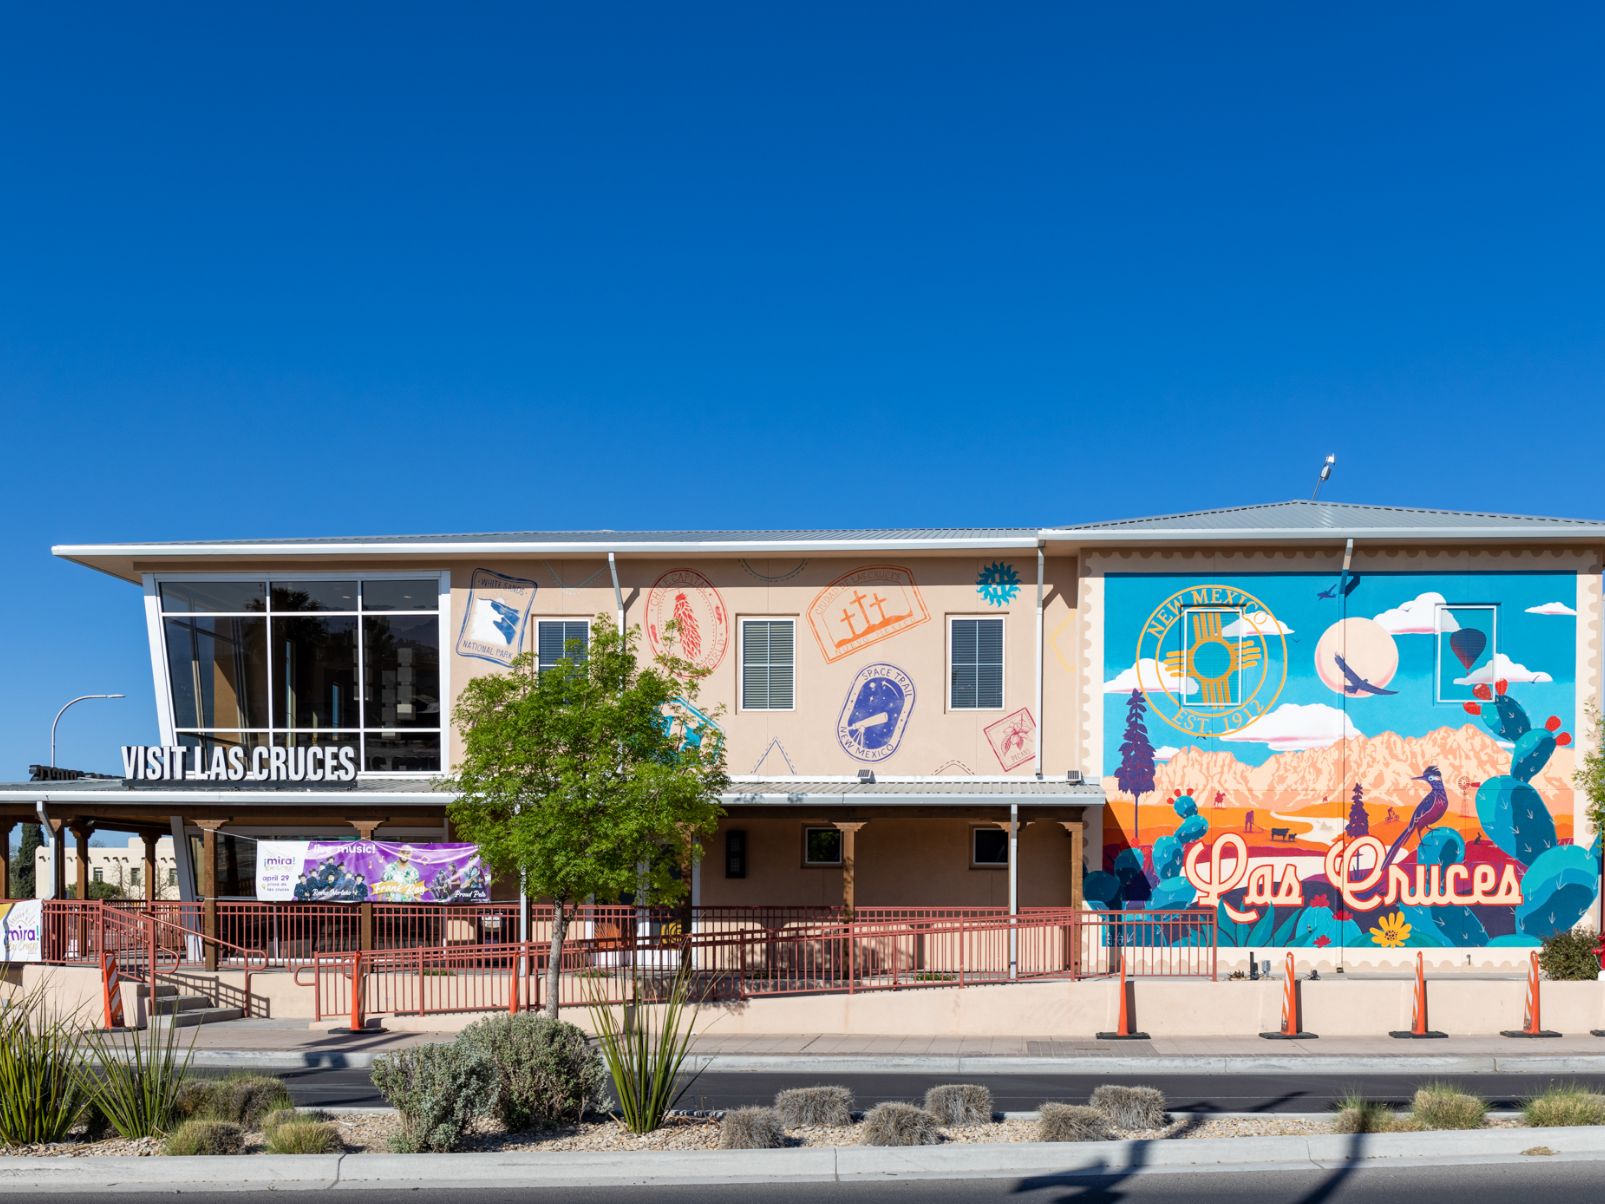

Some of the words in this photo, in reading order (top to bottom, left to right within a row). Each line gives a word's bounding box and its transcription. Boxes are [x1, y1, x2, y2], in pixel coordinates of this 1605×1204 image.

[480, 578, 502, 589] WHITE
[503, 582, 525, 596] SANDS
[1147, 596, 1185, 639] NEW
[1191, 588, 1268, 625] MEXICO
[463, 640, 495, 656] NATIONAL
[495, 649, 513, 661] PARK
[861, 667, 892, 681] SPACE
[893, 672, 913, 698] TRAIL
[1171, 708, 1213, 734] EST.
[1223, 700, 1265, 732] 1912
[840, 726, 855, 749] NEW
[855, 743, 895, 759] MEXICO
[121, 746, 187, 780] VISIT
[194, 746, 247, 781] LAS
[252, 746, 357, 781] CRUCES
[262, 874, 279, 882] april
[281, 874, 290, 882] 29
[1184, 832, 1305, 925] Las
[1324, 835, 1524, 912] Cruces
